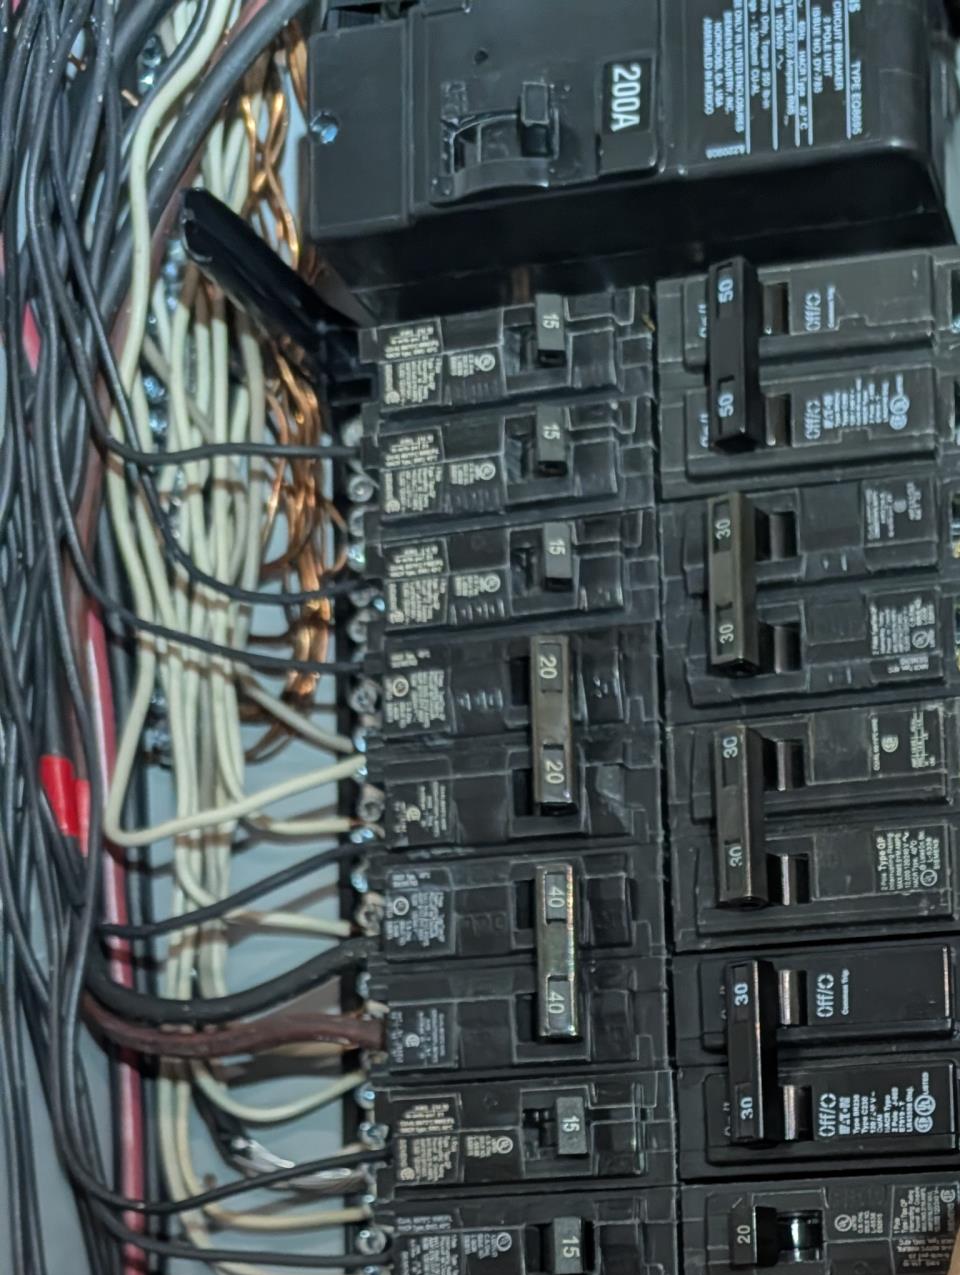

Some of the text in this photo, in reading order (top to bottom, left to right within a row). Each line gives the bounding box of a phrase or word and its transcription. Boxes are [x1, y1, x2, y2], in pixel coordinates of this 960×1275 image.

[851, 61, 861, 91] TYPE
[611, 62, 641, 133] 200A
[718, 278, 734, 304] 50
[542, 312, 560, 331] 15
[718, 393, 734, 417] 50
[542, 423, 561, 440] 15
[715, 517, 732, 541] 30
[548, 538, 566, 556] 15
[719, 622, 735, 645] 30
[539, 655, 557, 680] 20
[722, 735, 738, 760] 30
[545, 760, 565, 785] 20
[729, 845, 744, 868] 30
[547, 886, 565, 909] 40
[548, 992, 565, 1015] 40
[734, 982, 749, 1006] 30
[740, 1096, 754, 1121] 30
[562, 1115, 580, 1134] 15
[737, 1223, 752, 1245] 20
[562, 1238, 580, 1259] 15
